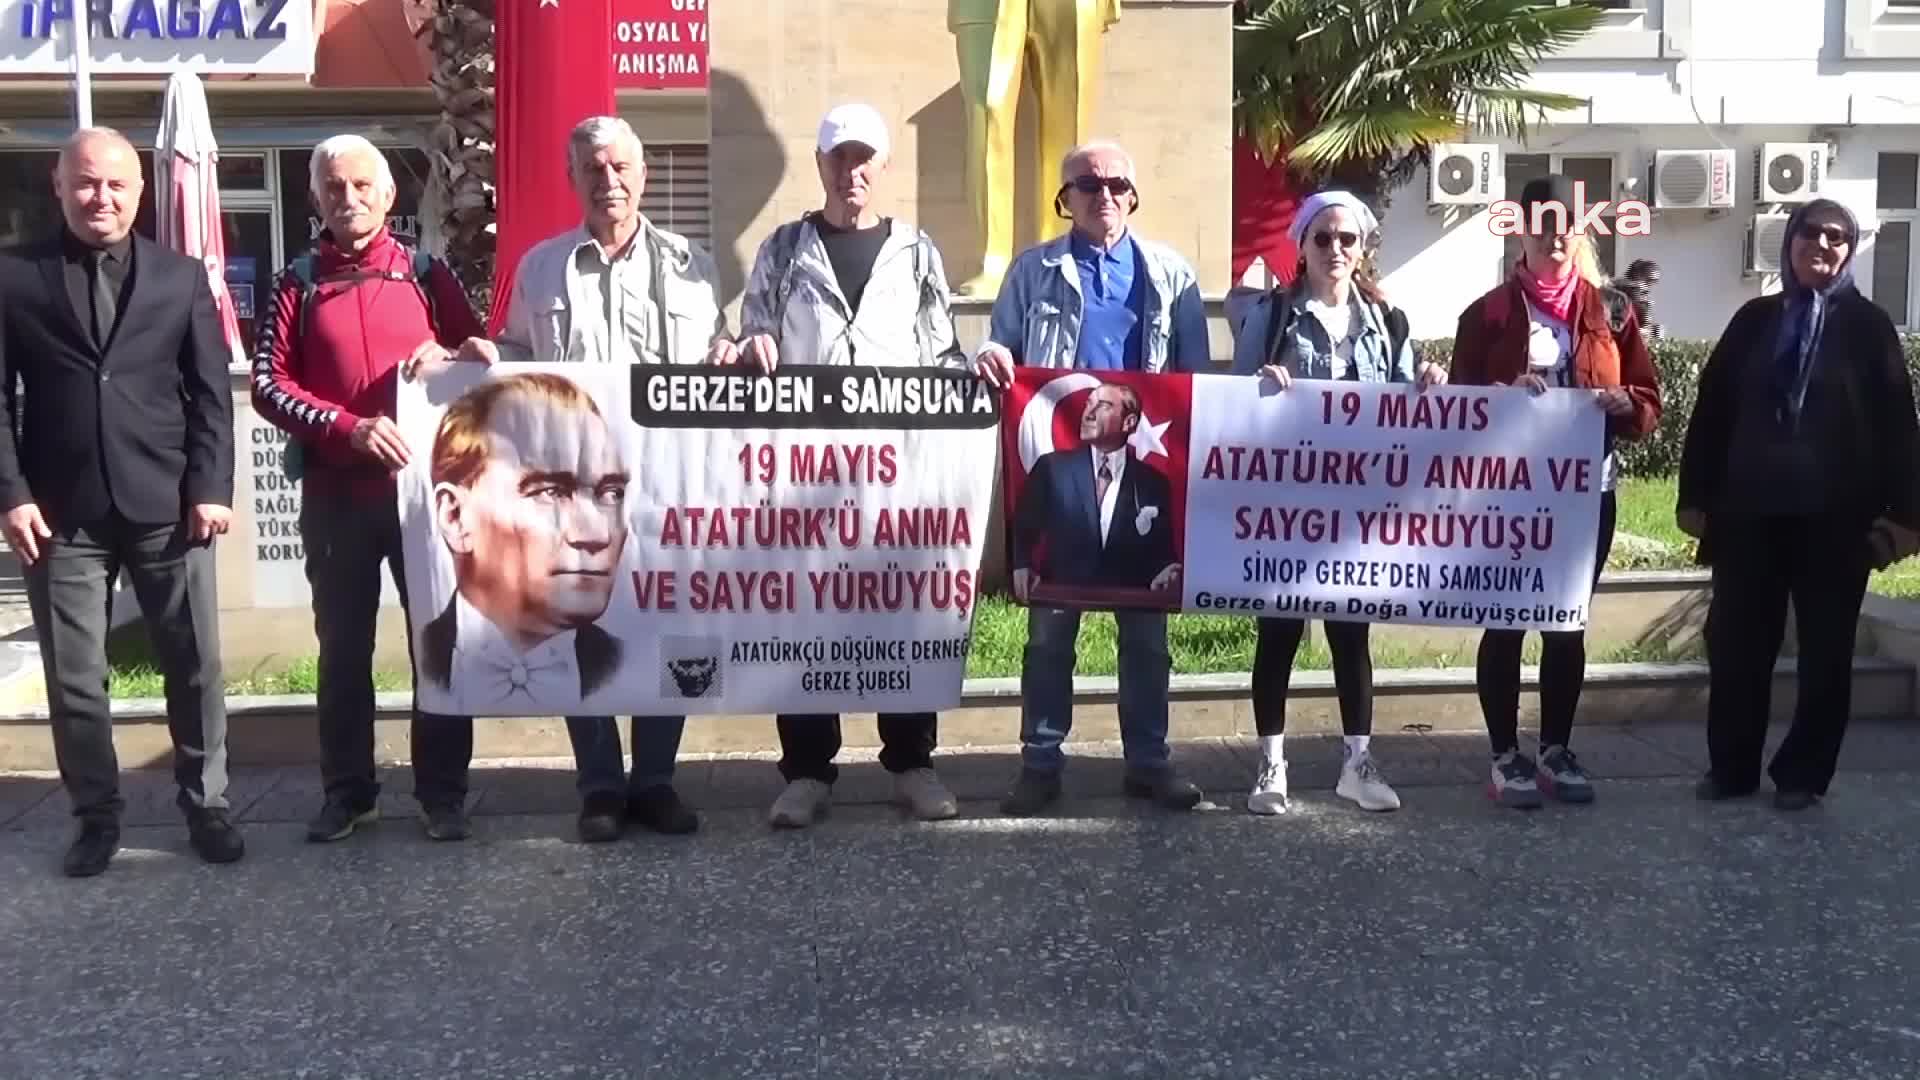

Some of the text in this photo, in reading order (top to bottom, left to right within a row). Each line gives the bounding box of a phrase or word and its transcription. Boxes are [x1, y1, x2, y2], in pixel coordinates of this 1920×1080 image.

[612, 21, 681, 42] OSYAL
[612, 53, 699, 80] ANIŞMA
[647, 375, 813, 413] GERZE'DEN
[841, 376, 993, 414] SAMSUN'A
[1321, 390, 1489, 432] 19 MAYIS
[738, 443, 897, 485] 19 MAYIS
[1202, 440, 1591, 493] ATATÜRK'Ü ANMA VE
[660, 500, 972, 547] ATATÜRK'Ü ANMA
[1235, 502, 1554, 561] SAYGI YÜRÜYÜŞÜ
[632, 562, 982, 619] VE SAYGI YÜRÜYÜŞ
[1243, 550, 1544, 593] SİNOP GERZE'DEN SAMSUN'A
[1195, 591, 1582, 625] Gerze Ultra Doğa Yürüyüşcüleri
[731, 635, 825, 667] ATATÜRKÇÜ
[831, 634, 905, 667] DÜŞÜNCE
[802, 665, 911, 696] GERZE ŞUBESİ
